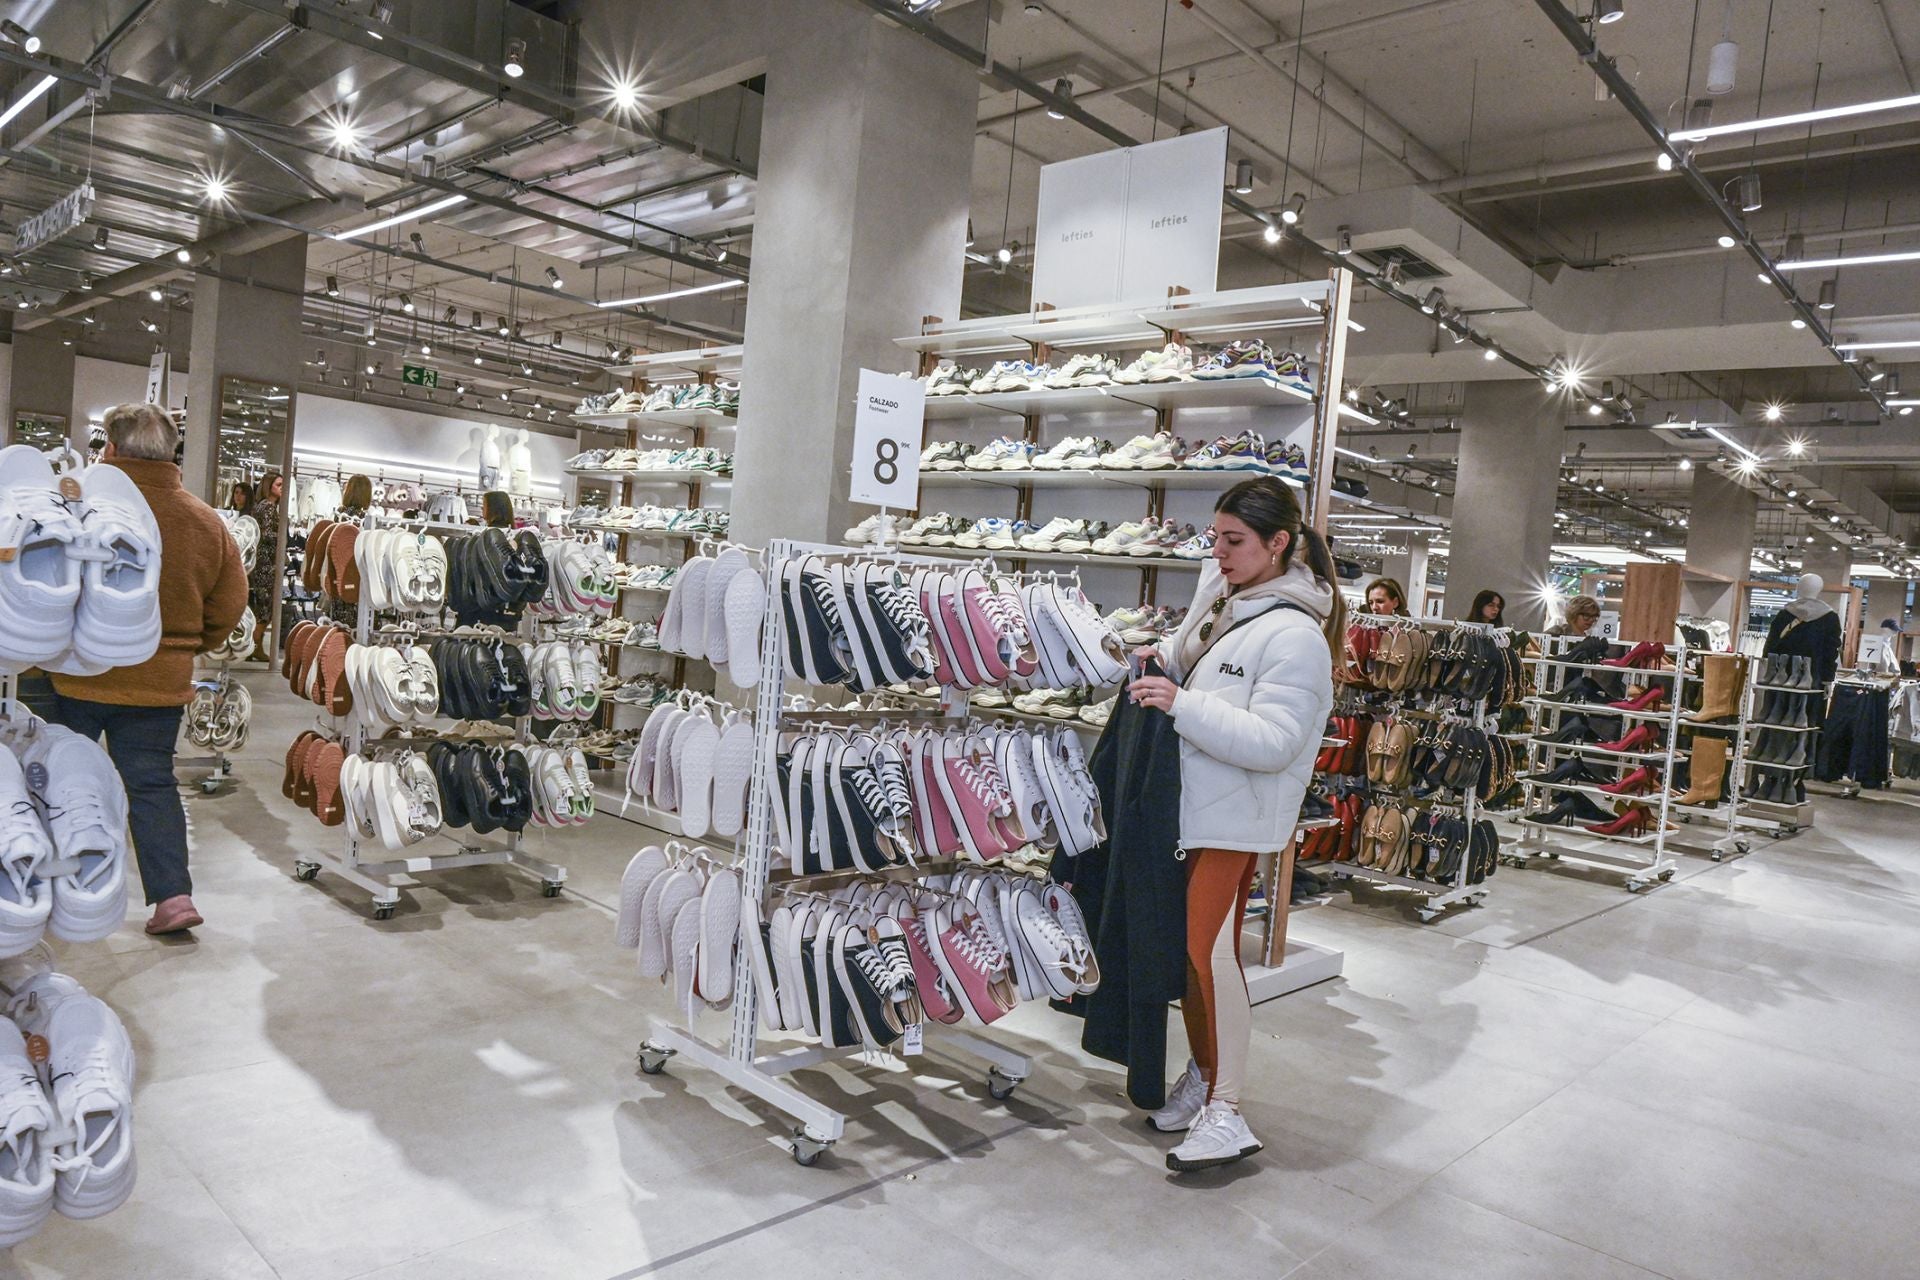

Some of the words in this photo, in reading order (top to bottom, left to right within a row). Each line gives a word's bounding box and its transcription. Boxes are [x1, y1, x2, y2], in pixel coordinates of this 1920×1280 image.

[1150, 214, 1189, 230] lefties
[1061, 229, 1094, 243] lefties
[149, 382, 157, 403] 3
[869, 396, 899, 409] CALZADO
[873, 438, 899, 485] 8
[1603, 623, 1612, 634] 8
[1866, 647, 1876, 658] 7
[1219, 662, 1245, 678] FILA
